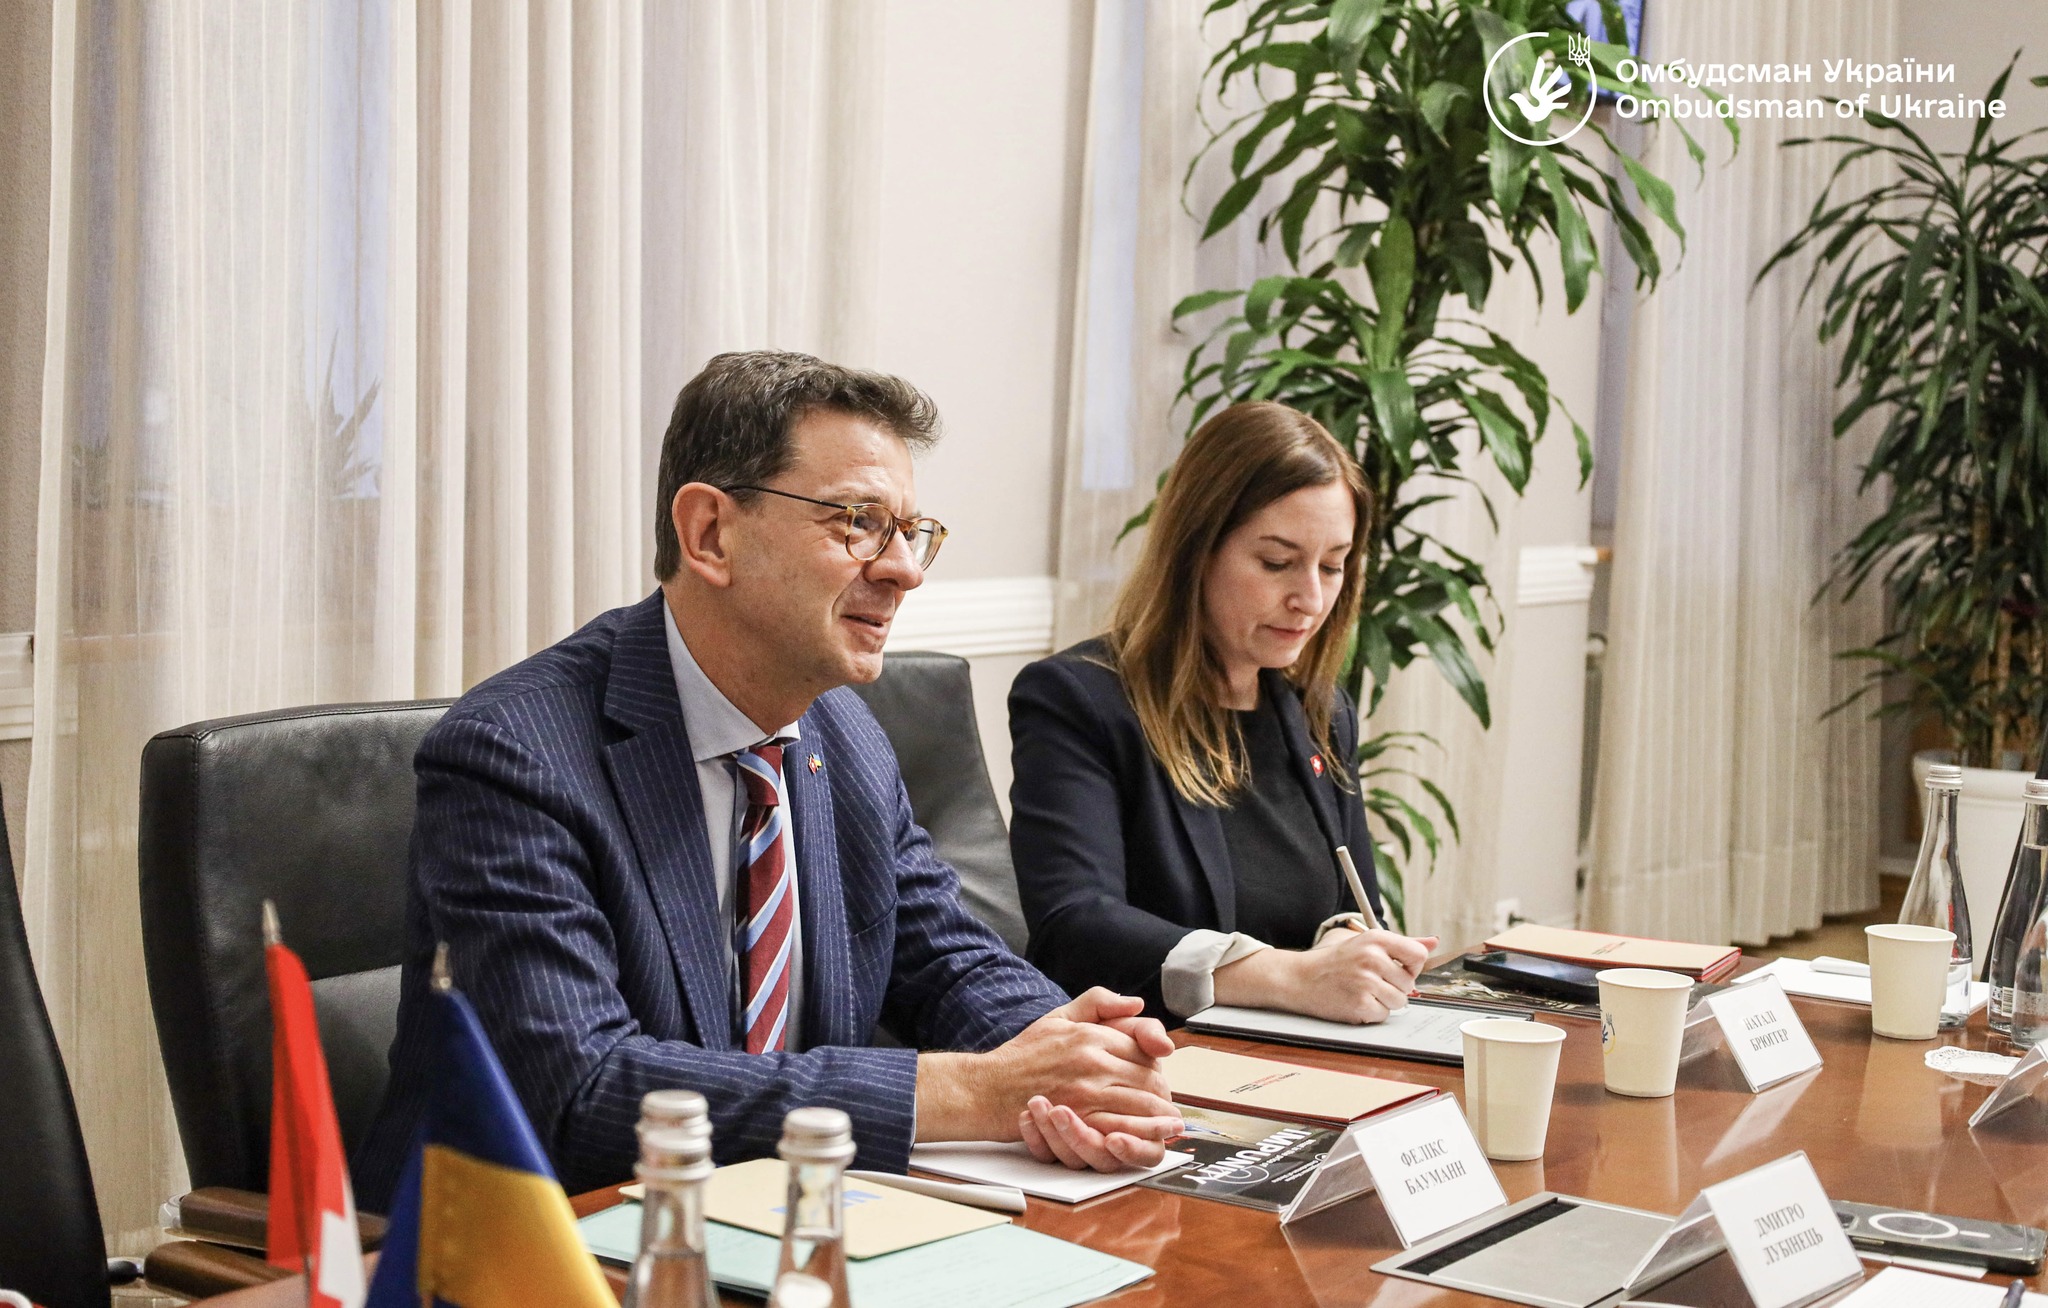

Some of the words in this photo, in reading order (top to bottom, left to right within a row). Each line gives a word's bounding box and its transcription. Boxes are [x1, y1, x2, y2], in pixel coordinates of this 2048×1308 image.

[1182, 1128, 1312, 1185] IMPUNITY
[1400, 1138, 1449, 1167] ФЕЛІКС
[1404, 1160, 1467, 1196] БАУМАНН
[1754, 1203, 1805, 1238] ДМИТРО
[1763, 1227, 1824, 1266] ЛУБІНЕЦЬ
